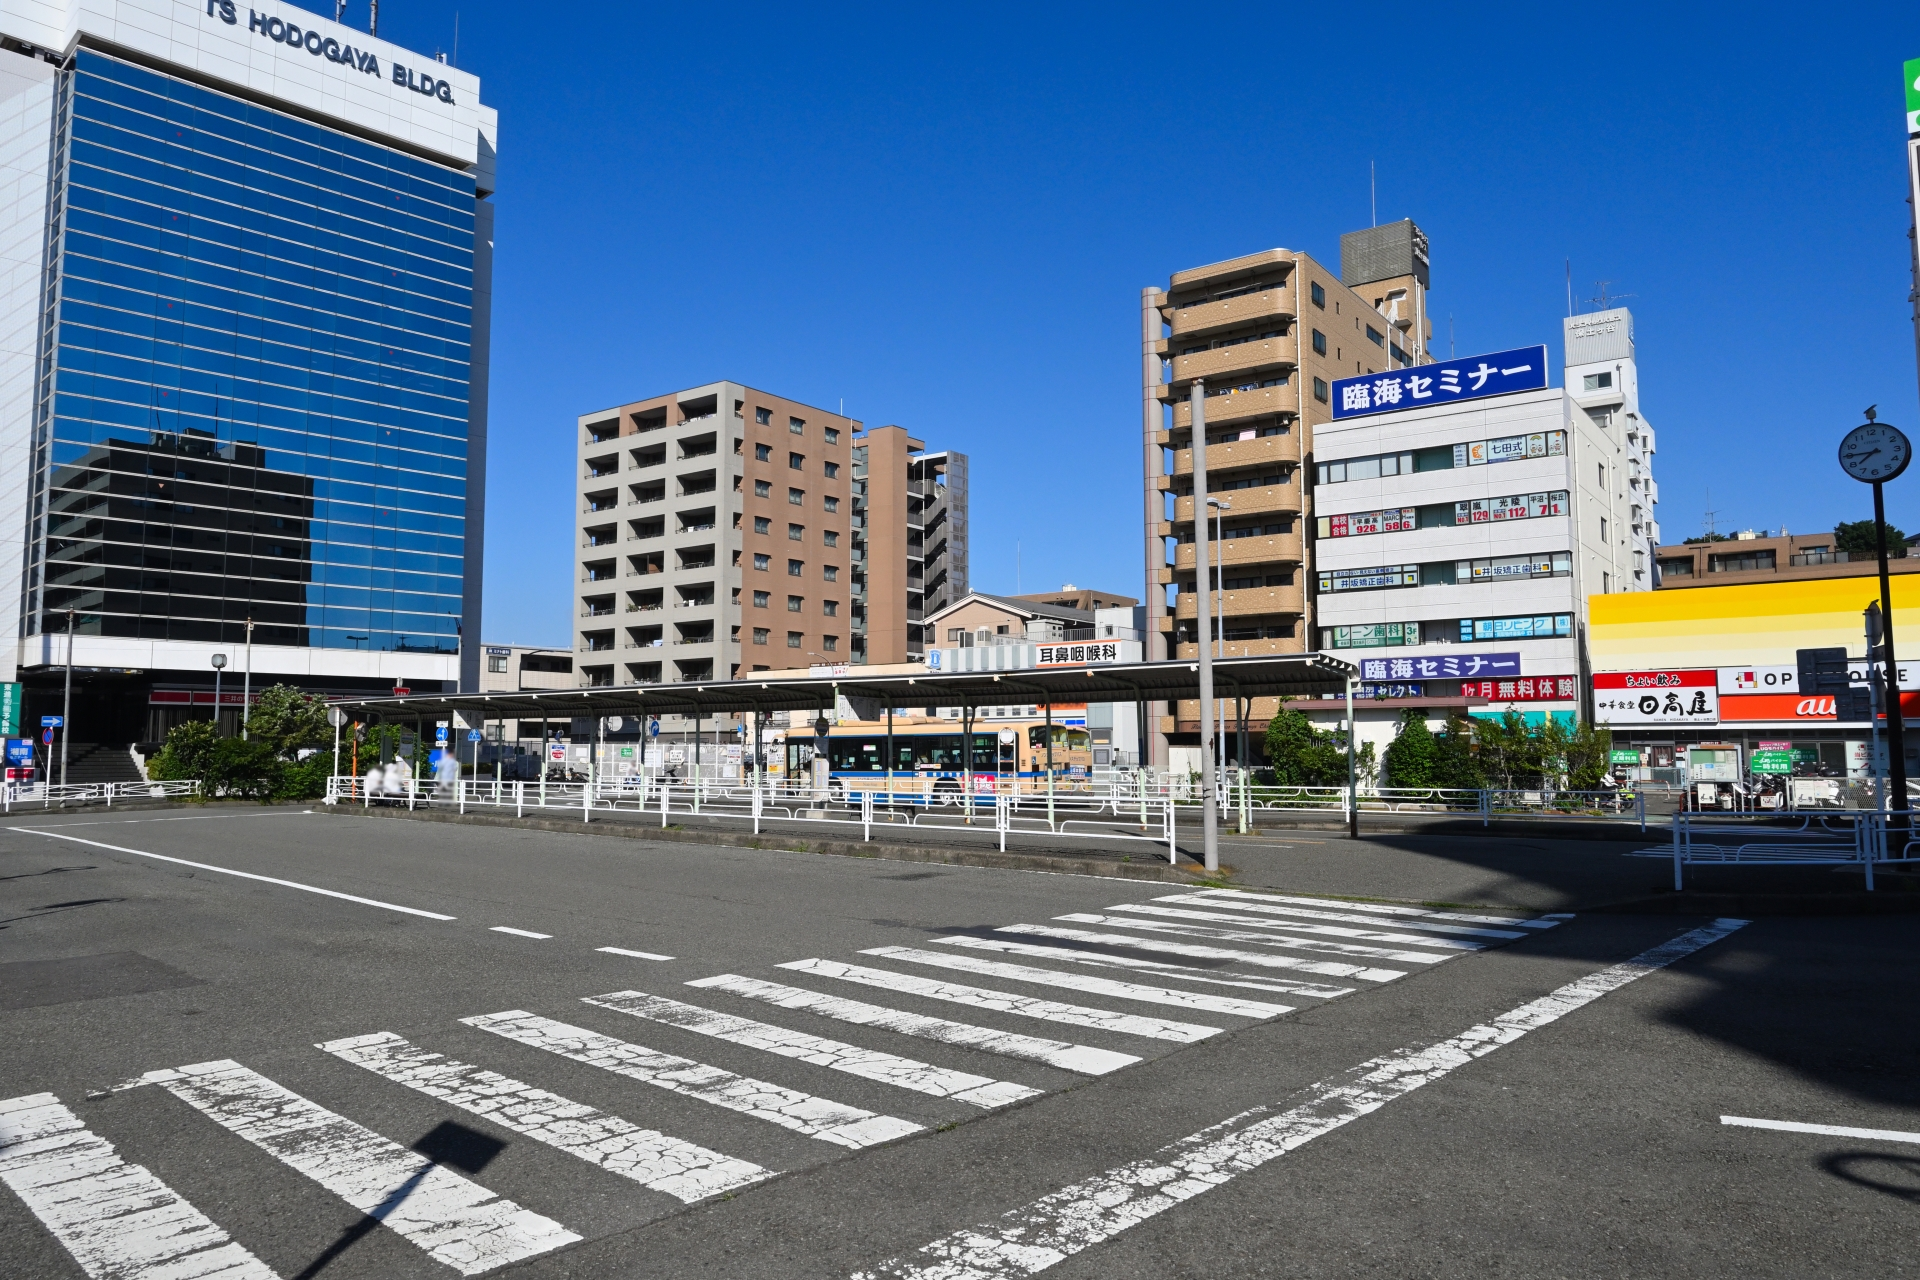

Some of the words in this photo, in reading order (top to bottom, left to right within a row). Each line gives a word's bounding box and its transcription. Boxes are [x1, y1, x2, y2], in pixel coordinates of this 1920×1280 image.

[249, 9, 381, 79] HODOGAYA
[1342, 363, 1532, 411] 臨海セミナー
[1889, 435, 1897, 443] 2
[1491, 441, 1523, 454] 七田式
[1481, 562, 1542, 576] 井坂矯正歯科
[1340, 576, 1394, 588] 井坂矯正歯科
[1340, 623, 1400, 639] レーン歯科
[1406, 626, 1417, 635] 3F
[1482, 617, 1549, 632] 朝日リビング
[1040, 644, 1117, 663] 耳鼻咽喉科
[1364, 656, 1516, 679] 臨海セミナー
[1625, 673, 1682, 687] ちょい飲み
[1461, 678, 1573, 699] 1ヶ月無料体験
[1598, 699, 1636, 710] 中華食堂
[1638, 690, 1713, 716] 日高屋
[1796, 697, 1838, 716] au
